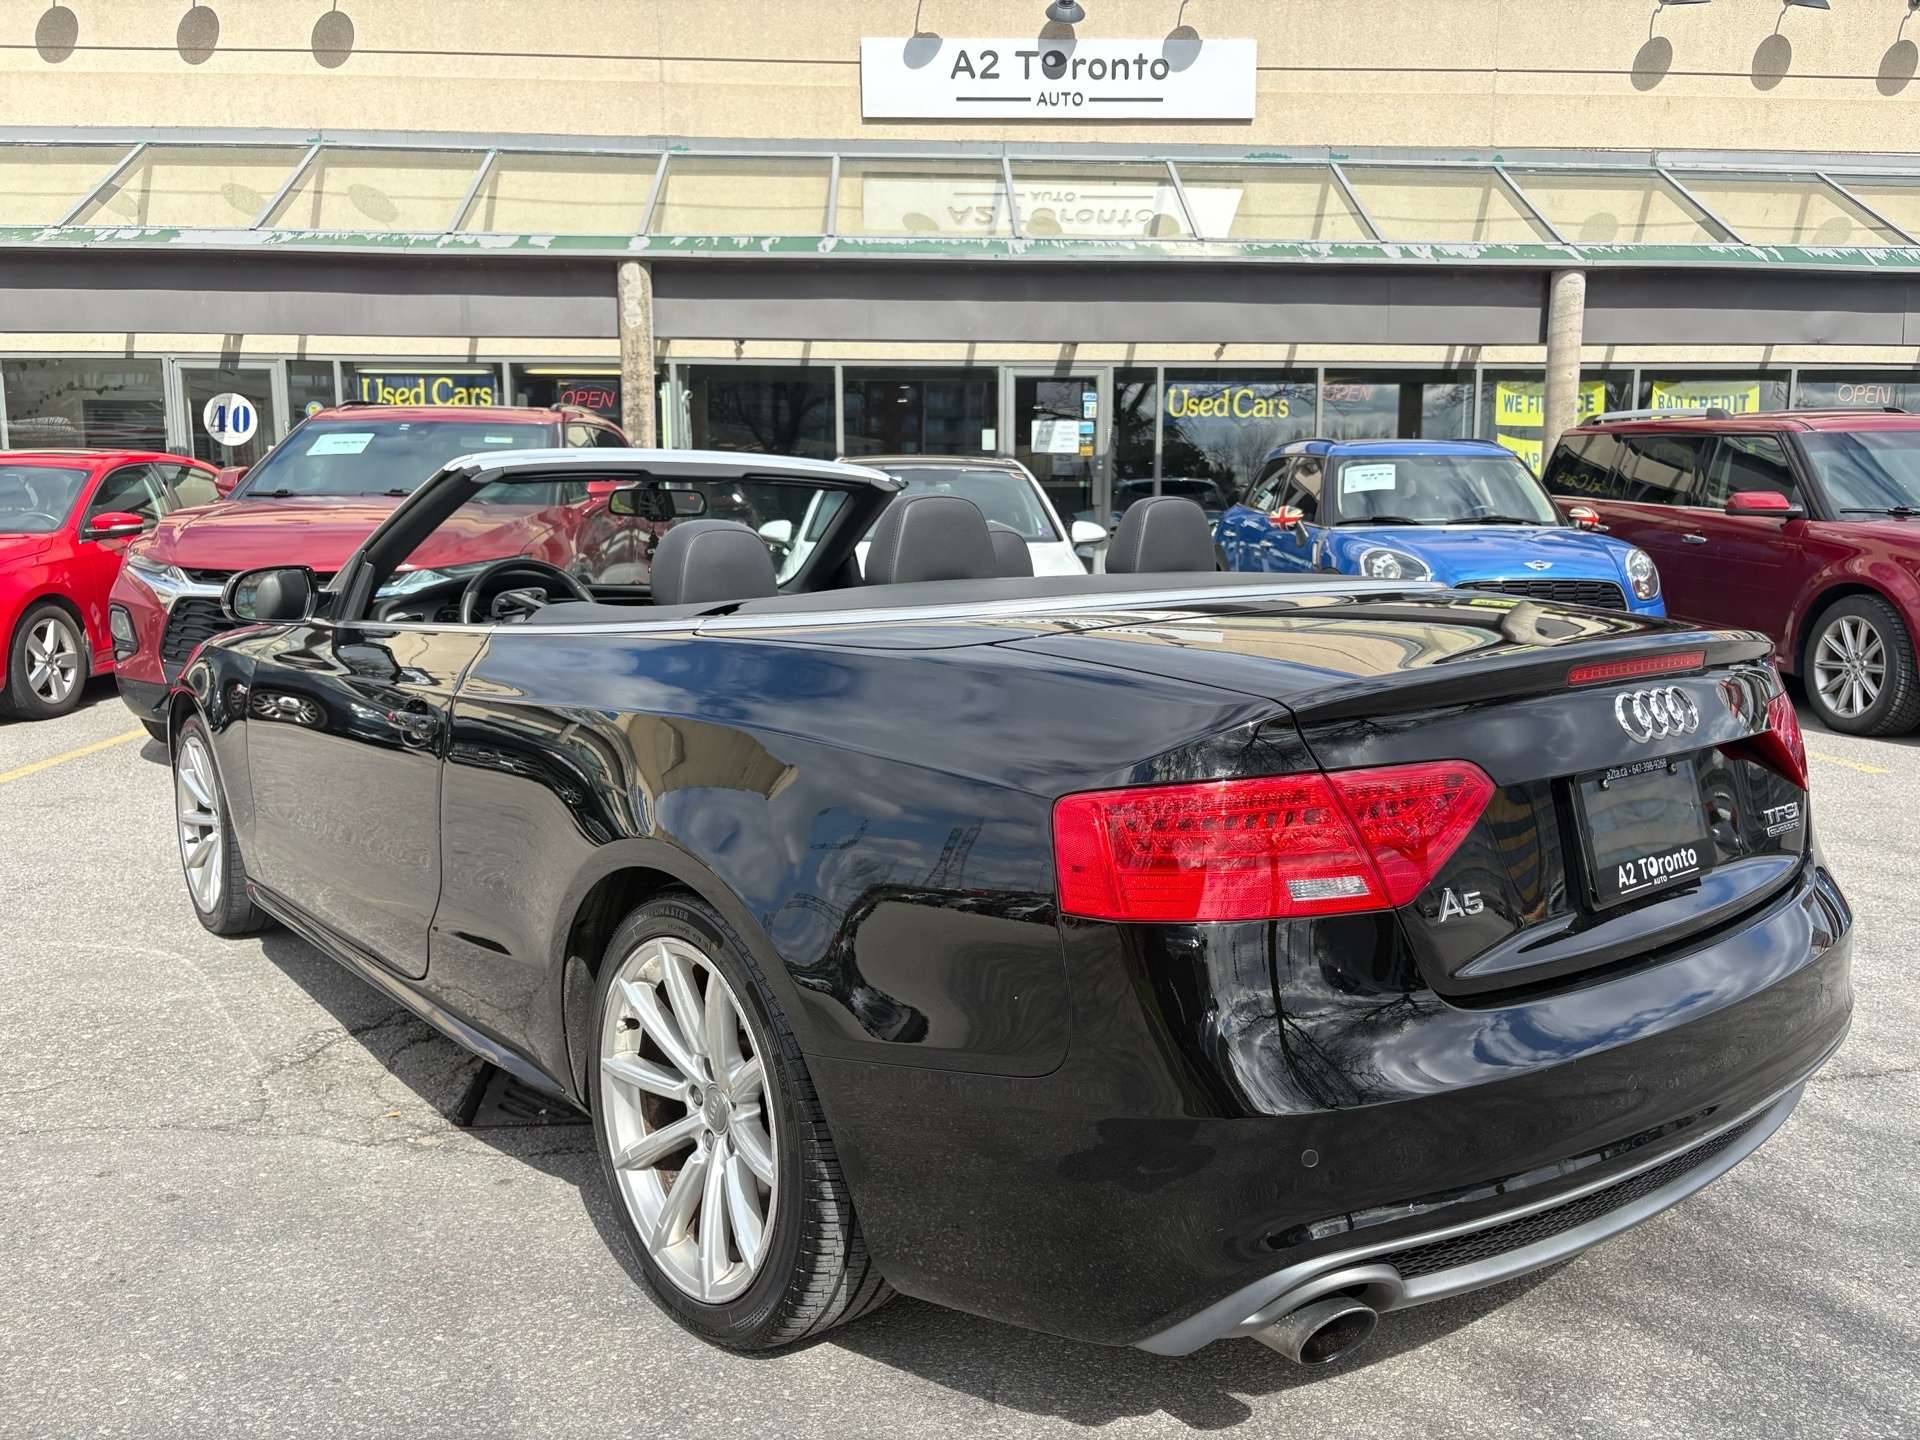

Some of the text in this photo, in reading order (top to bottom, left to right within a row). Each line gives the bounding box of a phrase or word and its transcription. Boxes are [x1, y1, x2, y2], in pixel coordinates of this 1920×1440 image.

[950, 50, 1001, 80] A2
[1036, 91, 1084, 106] AUTO
[361, 376, 493, 407] Used Cars
[560, 390, 616, 409] OPEN
[1167, 388, 1290, 418] Used Cars
[1503, 394, 1523, 413] WE
[1838, 384, 1892, 404] OPEN
[1658, 393, 1750, 415] BAD CREDIT
[210, 405, 251, 433] 40
[1763, 801, 1799, 825] TFSI
[1618, 862, 1638, 888] A2
[1654, 875, 1668, 885] AUTO
[1439, 887, 1485, 923] A5
